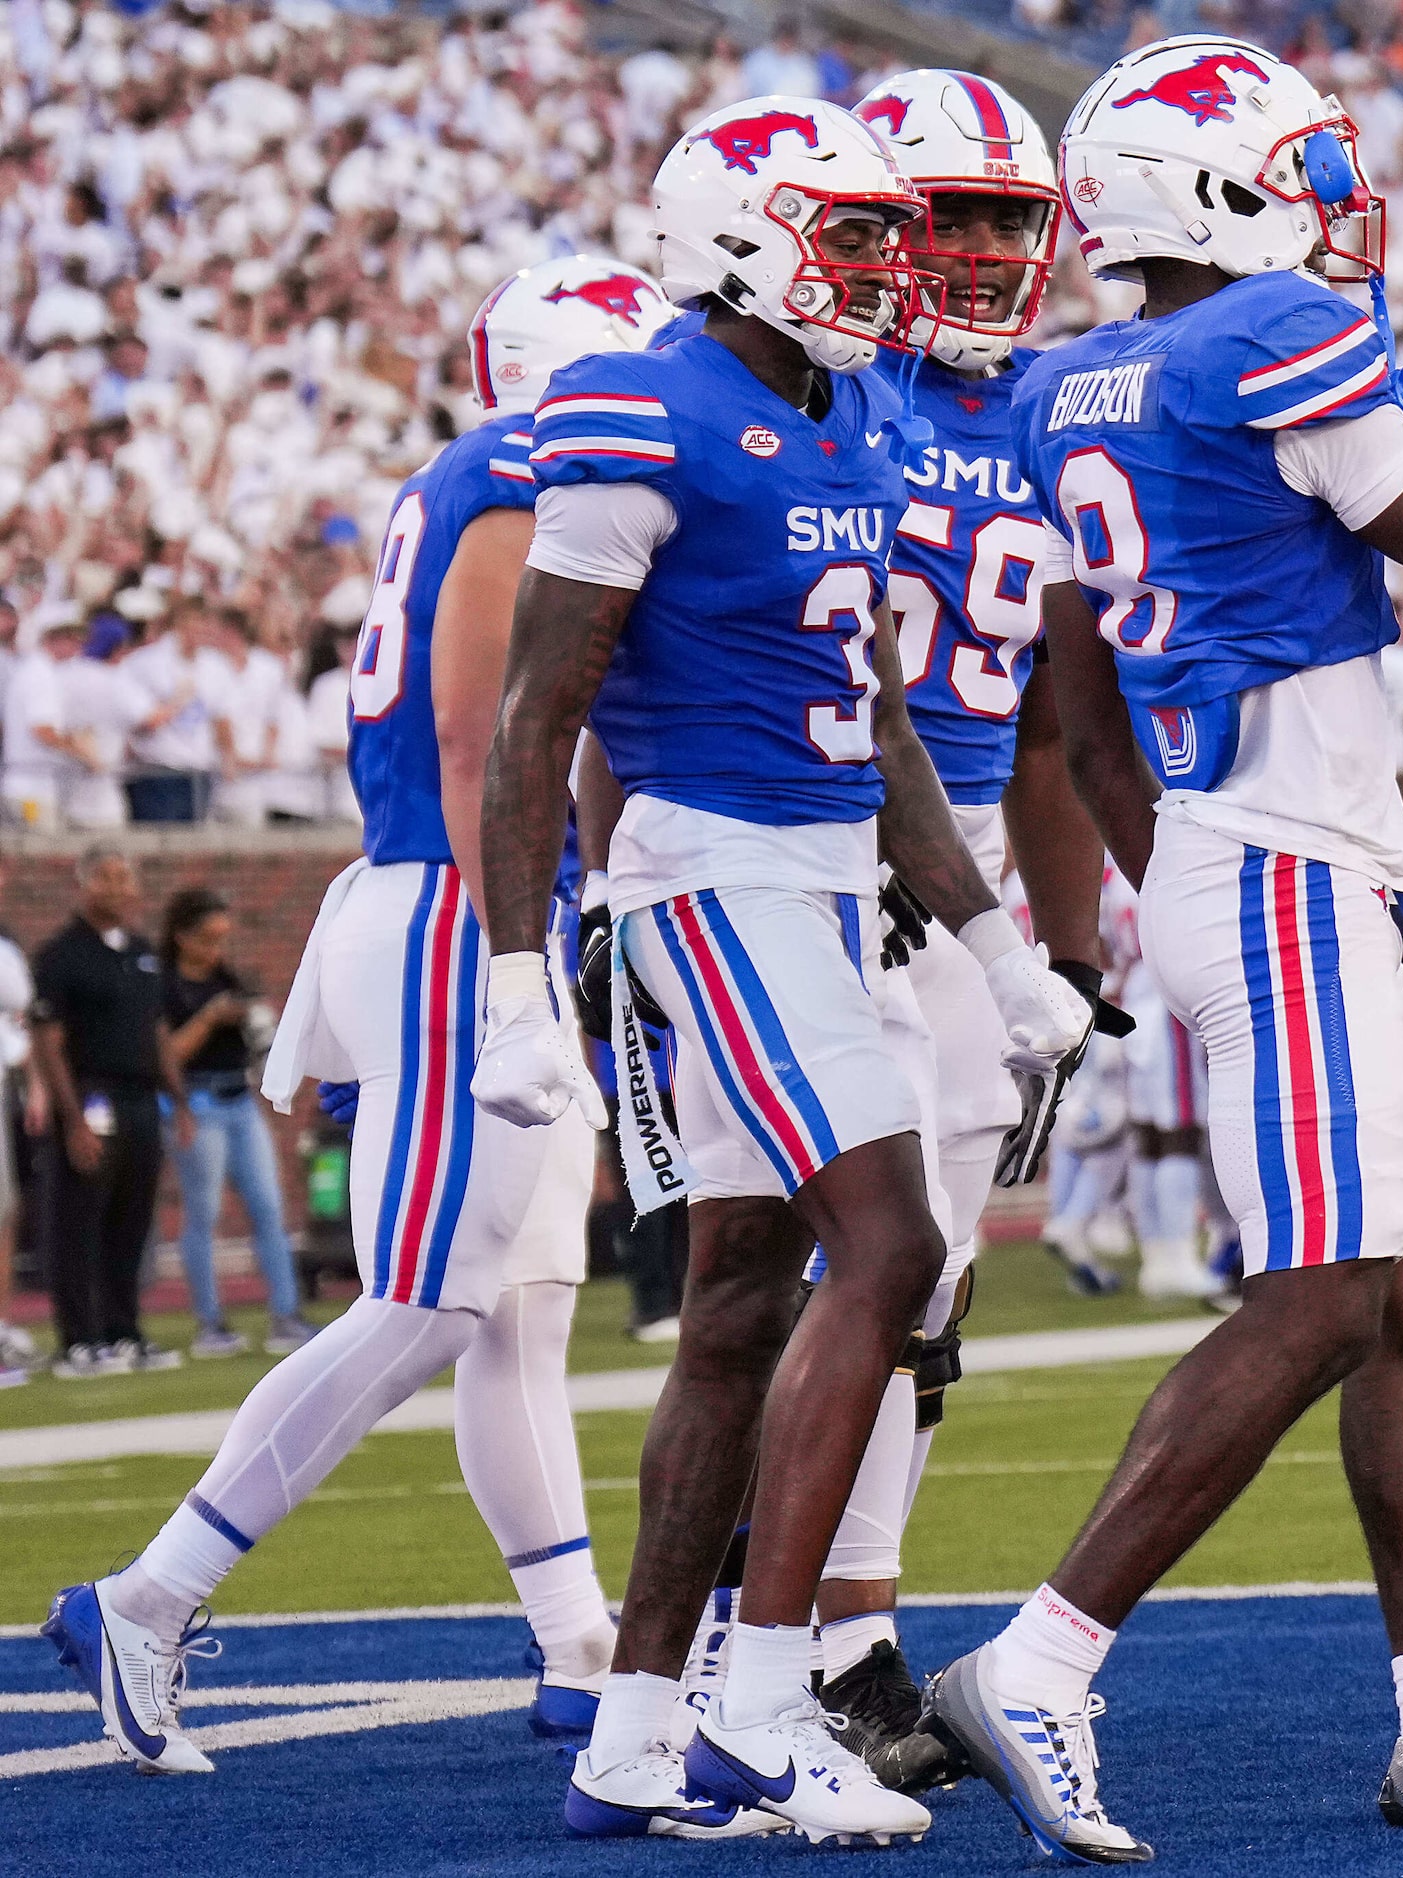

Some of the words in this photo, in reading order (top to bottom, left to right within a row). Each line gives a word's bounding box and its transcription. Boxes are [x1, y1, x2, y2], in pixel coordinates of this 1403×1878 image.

[747, 433, 774, 445] ACC
[1046, 362, 1151, 432] HUDSON
[786, 506, 883, 552] SMU
[902, 446, 1032, 503] SMU
[885, 497, 1048, 720] 59
[1056, 444, 1178, 657] 8
[799, 562, 882, 765] 3
[622, 1002, 685, 1193] POWERADE
